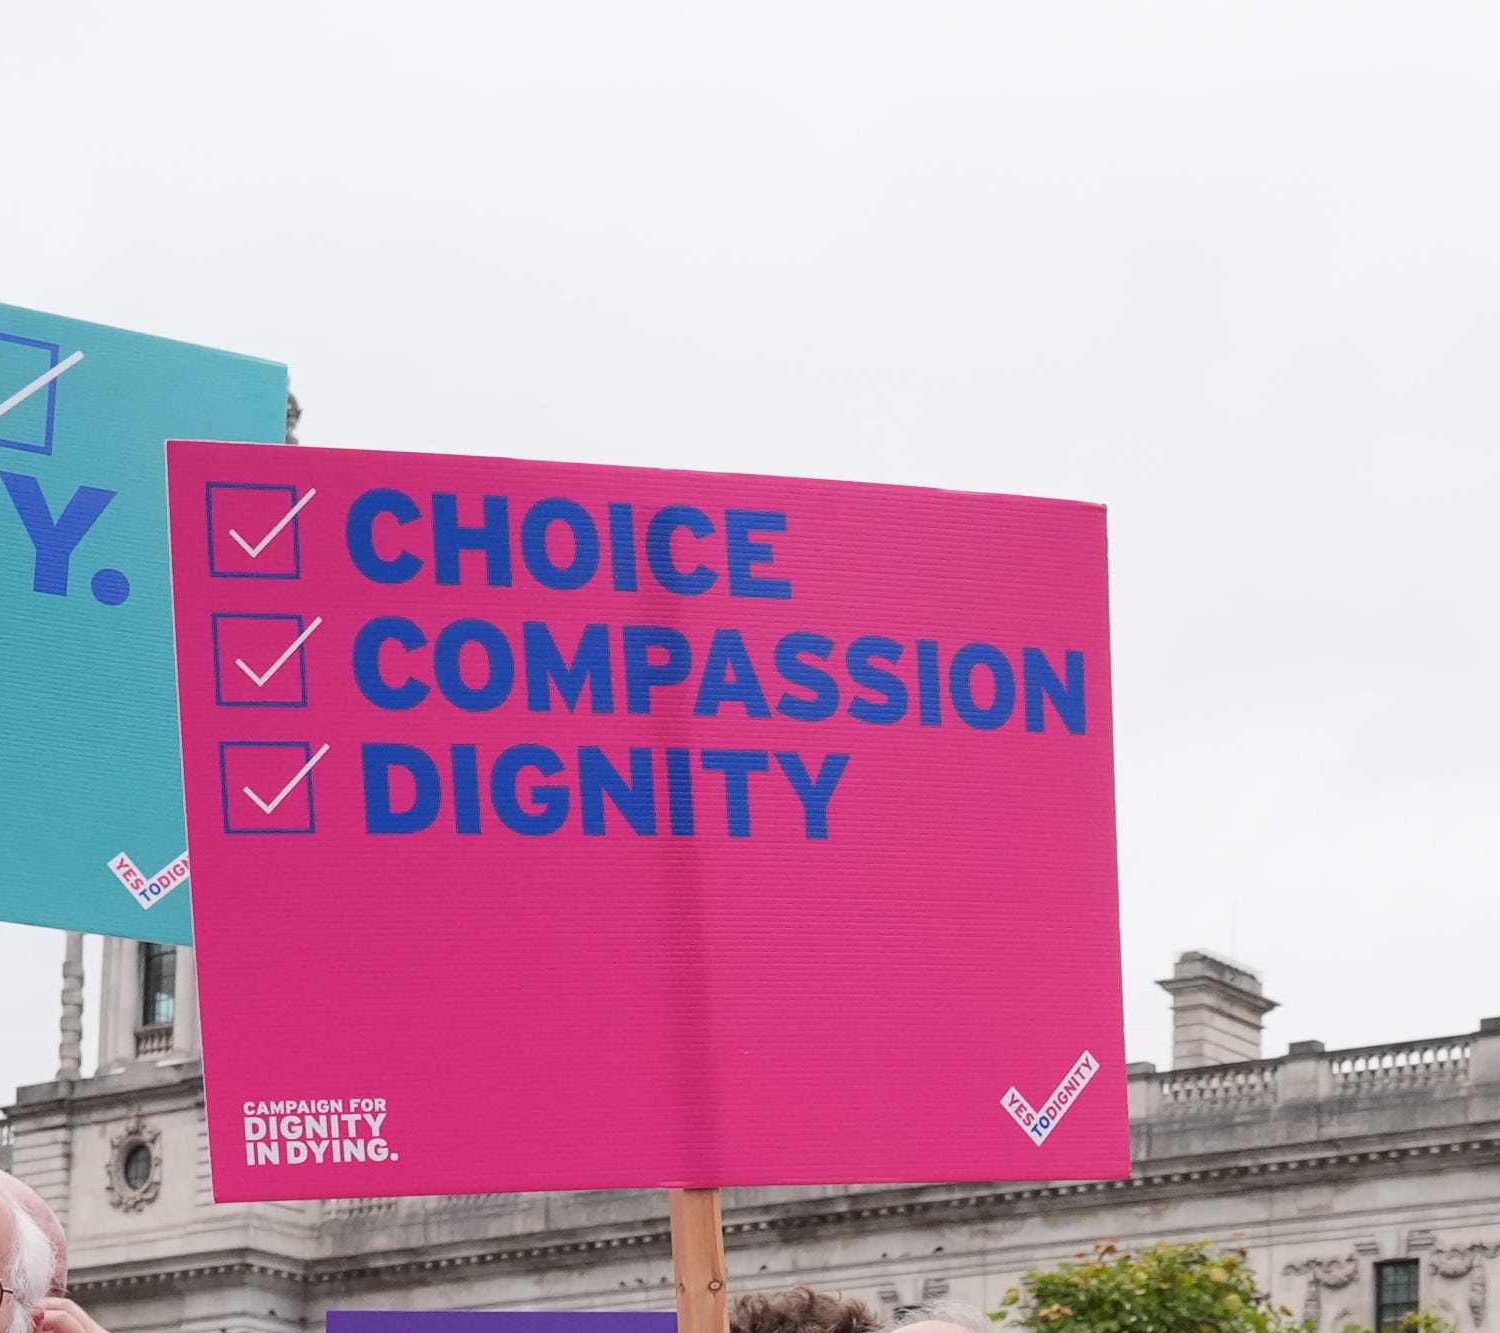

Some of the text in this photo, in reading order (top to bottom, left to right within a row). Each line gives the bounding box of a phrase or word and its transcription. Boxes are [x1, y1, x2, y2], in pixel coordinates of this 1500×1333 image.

[348, 490, 790, 598] CHOICE
[355, 617, 1085, 733] COMPASSION
[364, 745, 848, 838] DIGNITY
[116, 858, 145, 891] YES
[243, 1098, 387, 1116] CAMPAIGN FOR
[1008, 1093, 1035, 1127] YES
[244, 1113, 387, 1141] DIGNITY
[245, 1138, 400, 1166] IN DYING.
